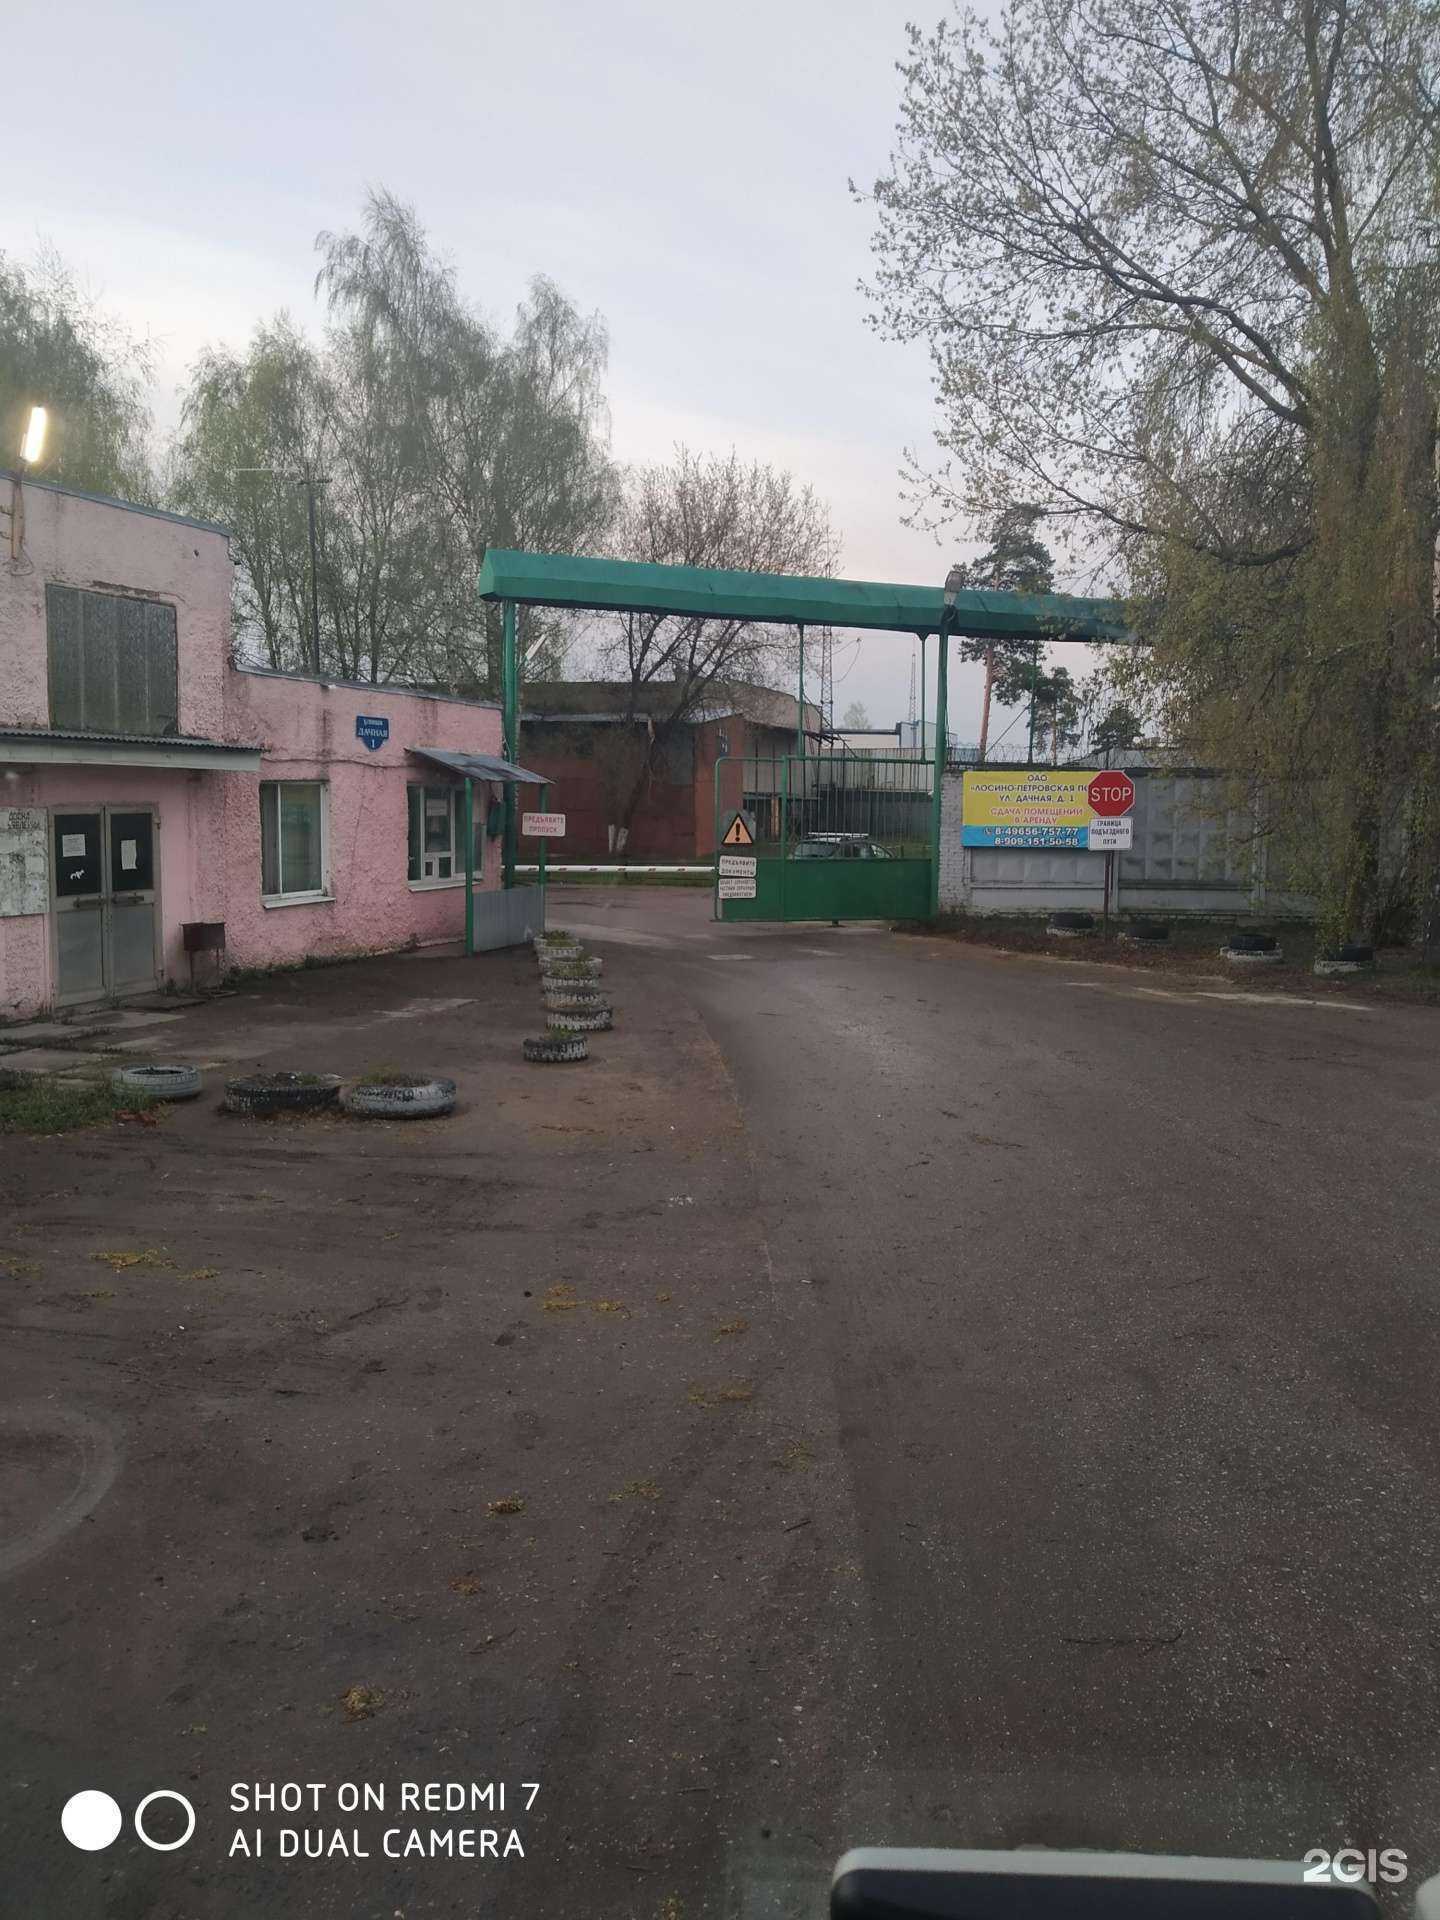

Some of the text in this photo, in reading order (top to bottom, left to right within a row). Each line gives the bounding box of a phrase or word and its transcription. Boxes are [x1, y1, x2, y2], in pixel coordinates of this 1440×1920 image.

[358, 727, 388, 738] ДАЧНАЯ
[371, 739, 375, 748] 1
[1027, 774, 1048, 782] ОАО
[1091, 787, 1132, 802] STOP
[990, 808, 1021, 817] СДАЧА
[1023, 817, 1057, 825] АРЕНДУ
[1091, 828, 1130, 836] ПОДЪЕЗДНОГО
[994, 837, 1078, 846] 8-909-151-50-58
[720, 868, 755, 876] ДОКУМЕНТЫ
